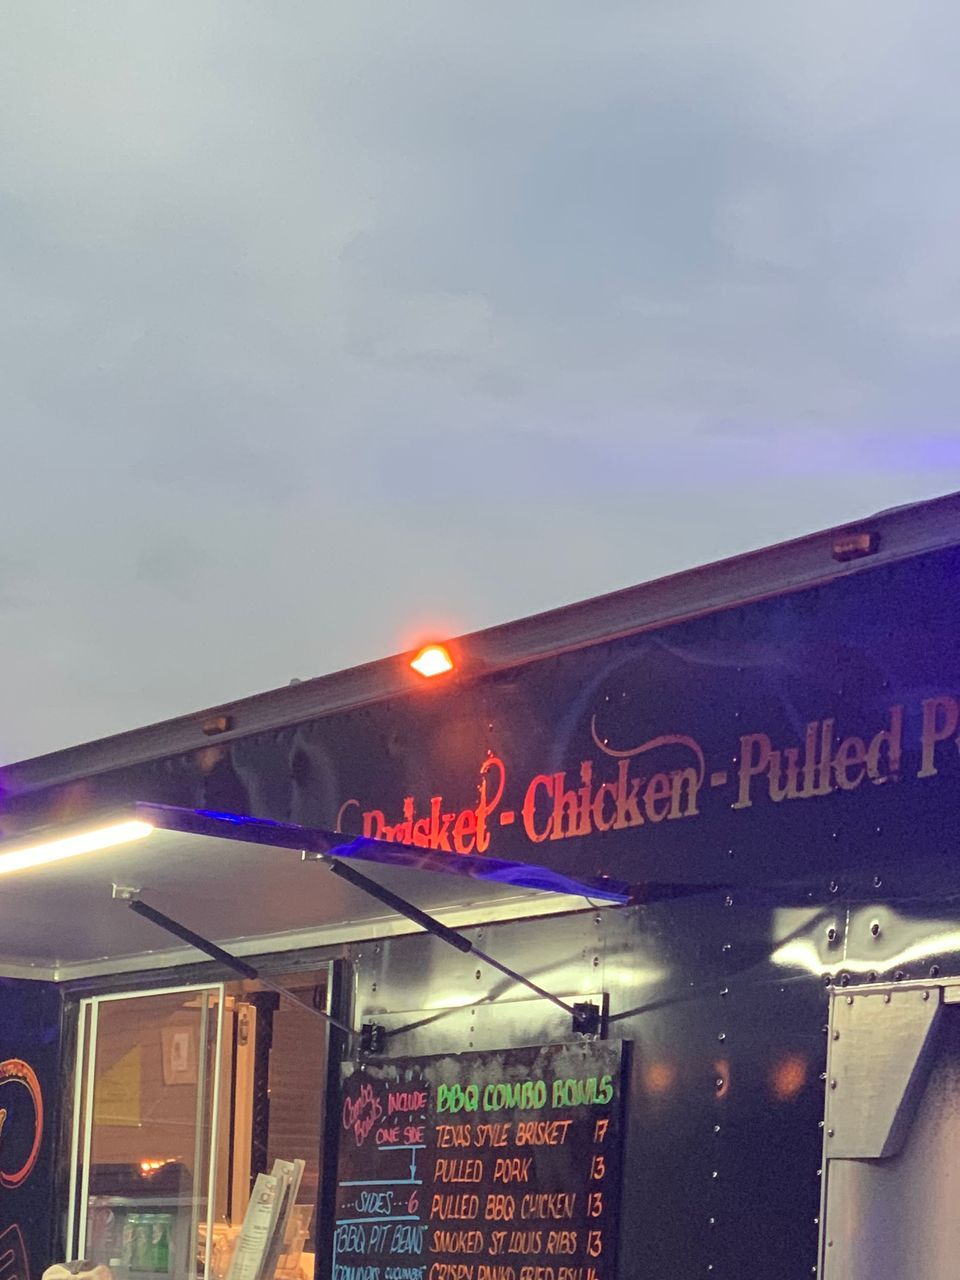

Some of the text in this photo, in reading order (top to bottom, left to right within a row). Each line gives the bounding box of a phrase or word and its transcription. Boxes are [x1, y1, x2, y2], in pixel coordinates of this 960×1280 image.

[522, 735, 703, 843] Chicken
[732, 705, 903, 809] Pulled
[917, 697, 960, 778] P
[388, 1091, 427, 1115] INCLUDE
[437, 1075, 613, 1113] BBQ COMBO BOWLS
[375, 1126, 426, 1144] ONE SIDE
[436, 1119, 609, 1148] TEXAS STYLE BRISKET 17
[433, 1156, 605, 1184] PULLED PORK 13
[430, 1192, 603, 1220] PULLED BBQ CHICKEN 13
[337, 1225, 366, 1254] BBQ
[367, 1225, 392, 1254] PIT
[430, 1230, 484, 1255] SMOKED
[508, 1231, 542, 1255] LOUIS
[547, 1230, 577, 1254] RIBS
[587, 1231, 602, 1257] 13
